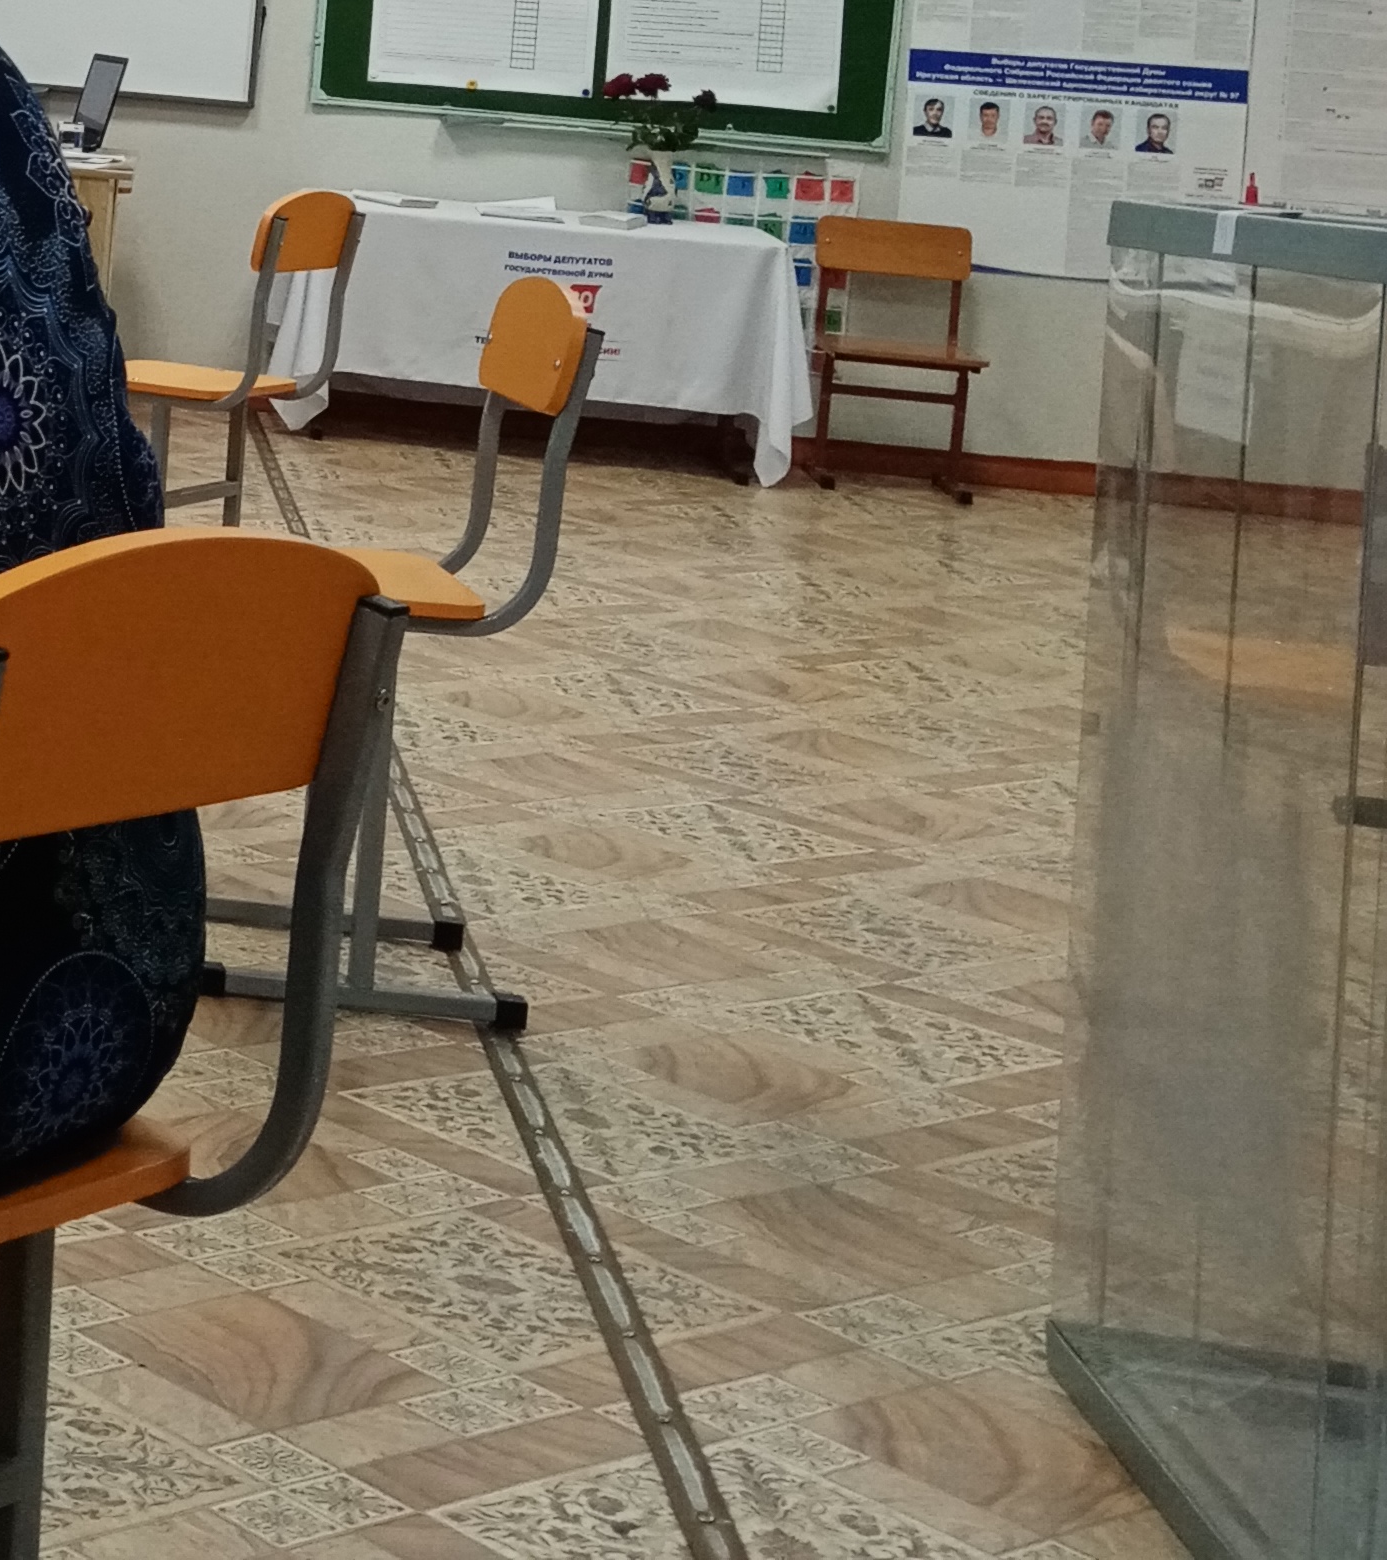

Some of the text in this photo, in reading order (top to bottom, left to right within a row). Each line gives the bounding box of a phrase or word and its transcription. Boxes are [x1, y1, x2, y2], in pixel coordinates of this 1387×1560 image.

[508, 251, 613, 267] ВЫБОРЫ ДЕПУТАТОВ
[504, 264, 614, 279] ГОСУДАРСТВЕННОЙ ДУМЫ
